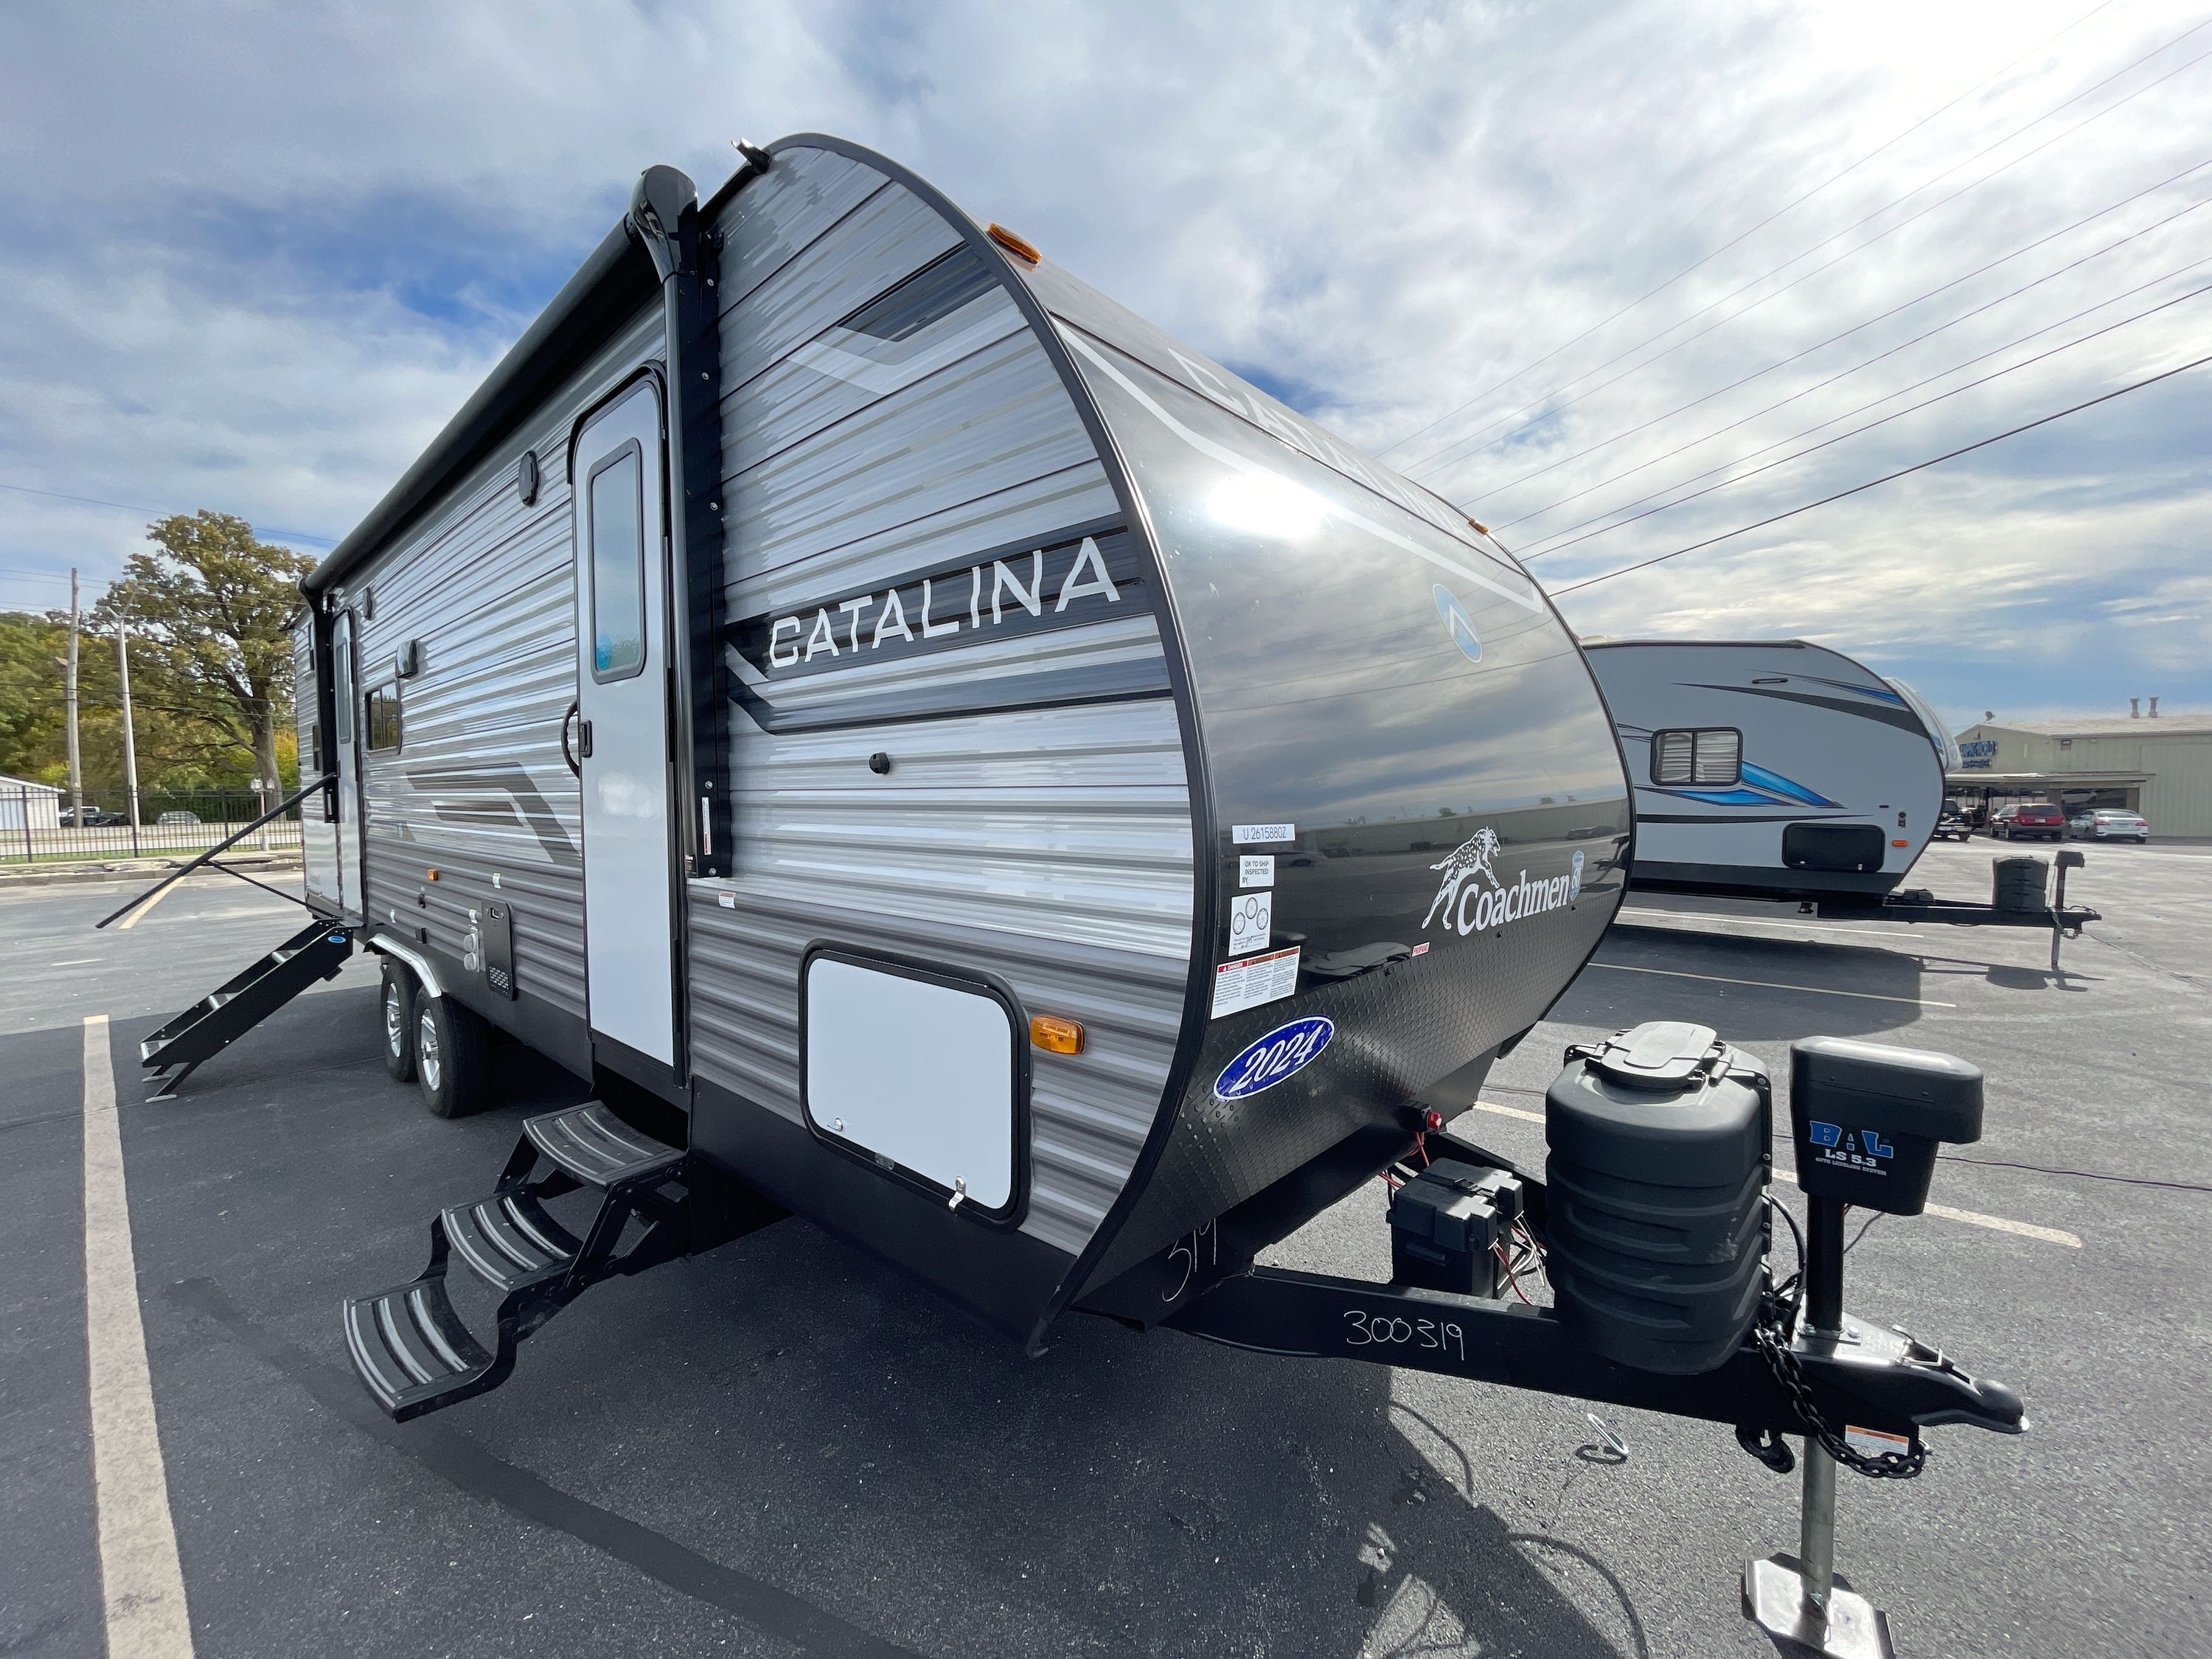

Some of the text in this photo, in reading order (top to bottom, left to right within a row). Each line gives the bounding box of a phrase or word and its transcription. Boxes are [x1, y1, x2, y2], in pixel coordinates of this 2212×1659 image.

[769, 537, 1121, 668] CATALINA
[1243, 828, 1249, 840] U
[1457, 869, 1570, 936] Coachmen
[1227, 961, 1244, 970] DANGER
[1228, 1022, 1325, 1093] 2024
[1809, 1120, 1894, 1159] BAL
[1825, 1148, 1877, 1167] LS 5.3
[1343, 1310, 1464, 1361] 300319
